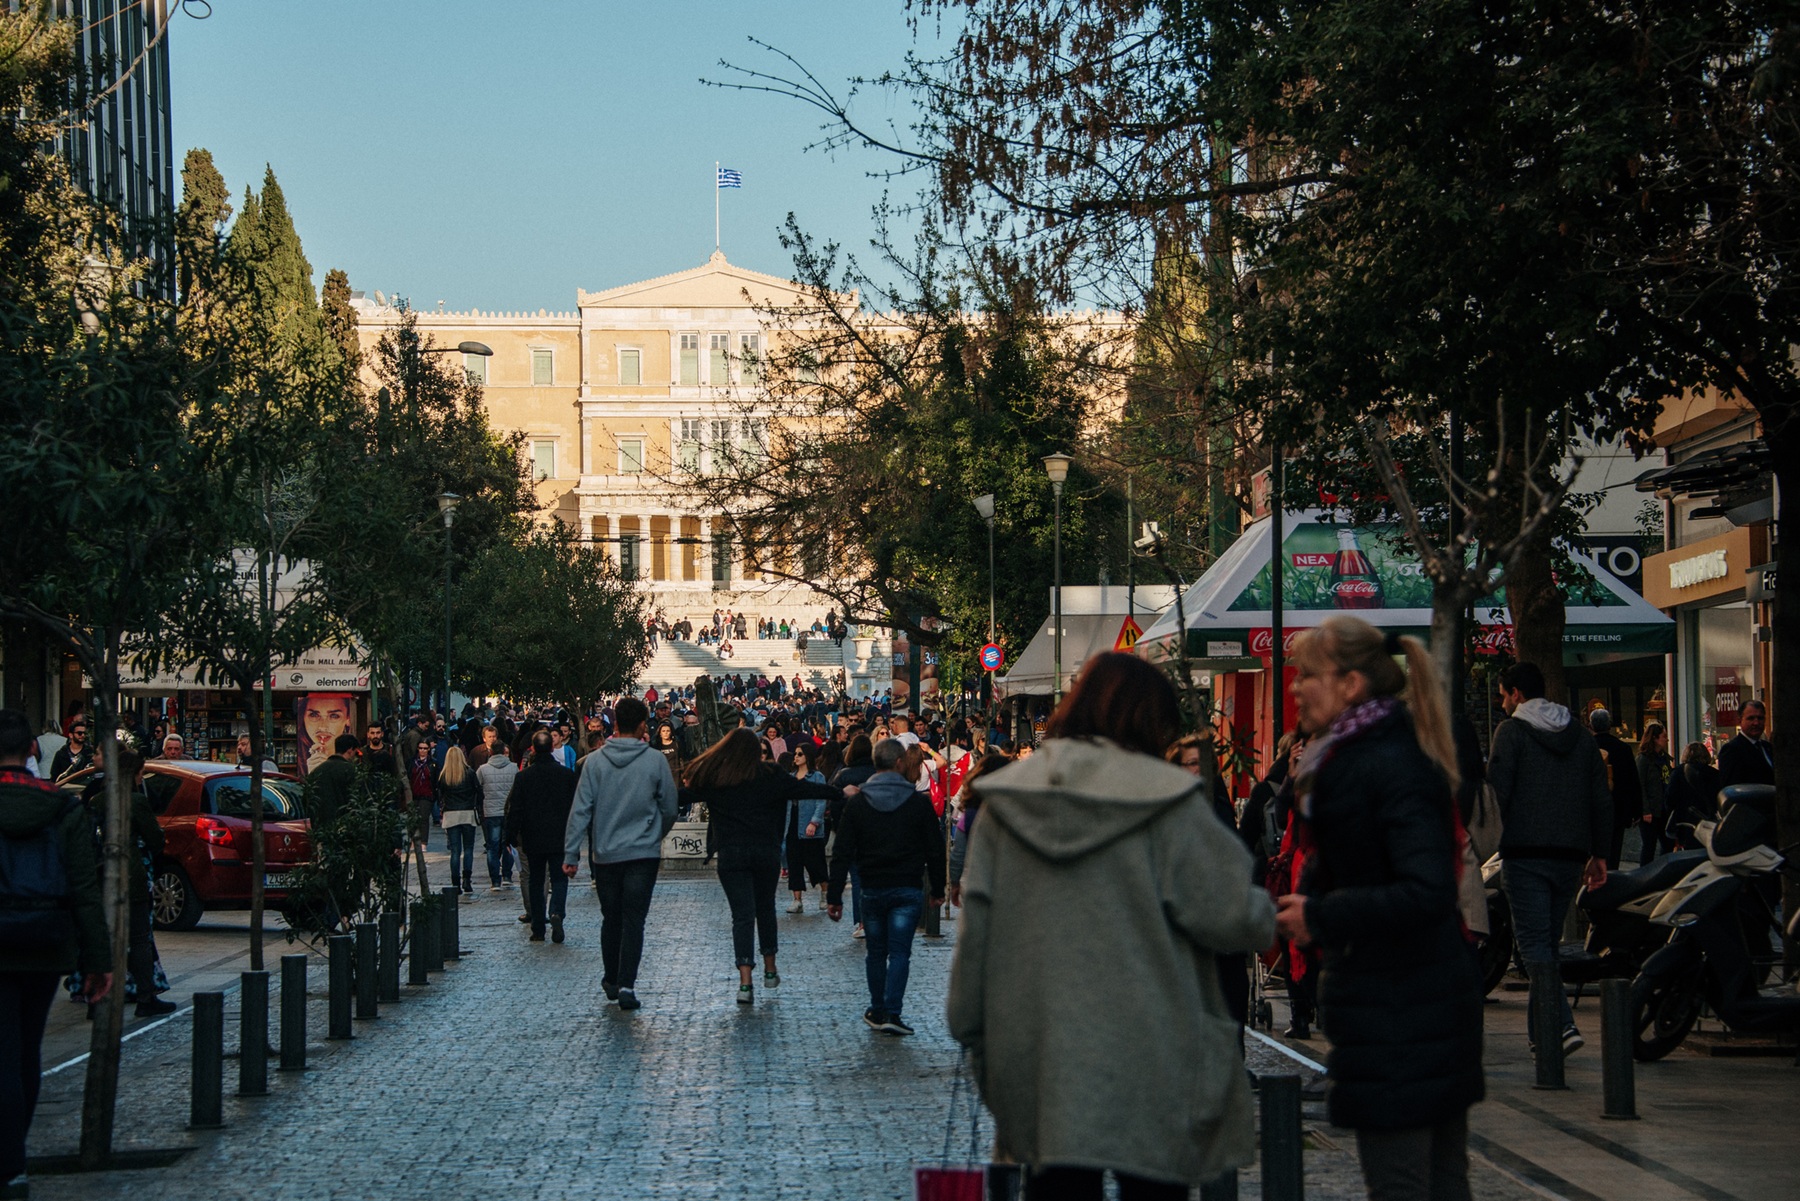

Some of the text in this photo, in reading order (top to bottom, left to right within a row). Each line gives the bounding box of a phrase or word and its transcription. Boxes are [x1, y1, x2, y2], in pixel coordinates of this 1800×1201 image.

[1331, 581, 1379, 593] Coca-Cola
[1571, 634, 1588, 642] THE
[1588, 634, 1622, 642] FEELING
[316, 677, 358, 687] element
[1716, 691, 1740, 712] OFFERS
